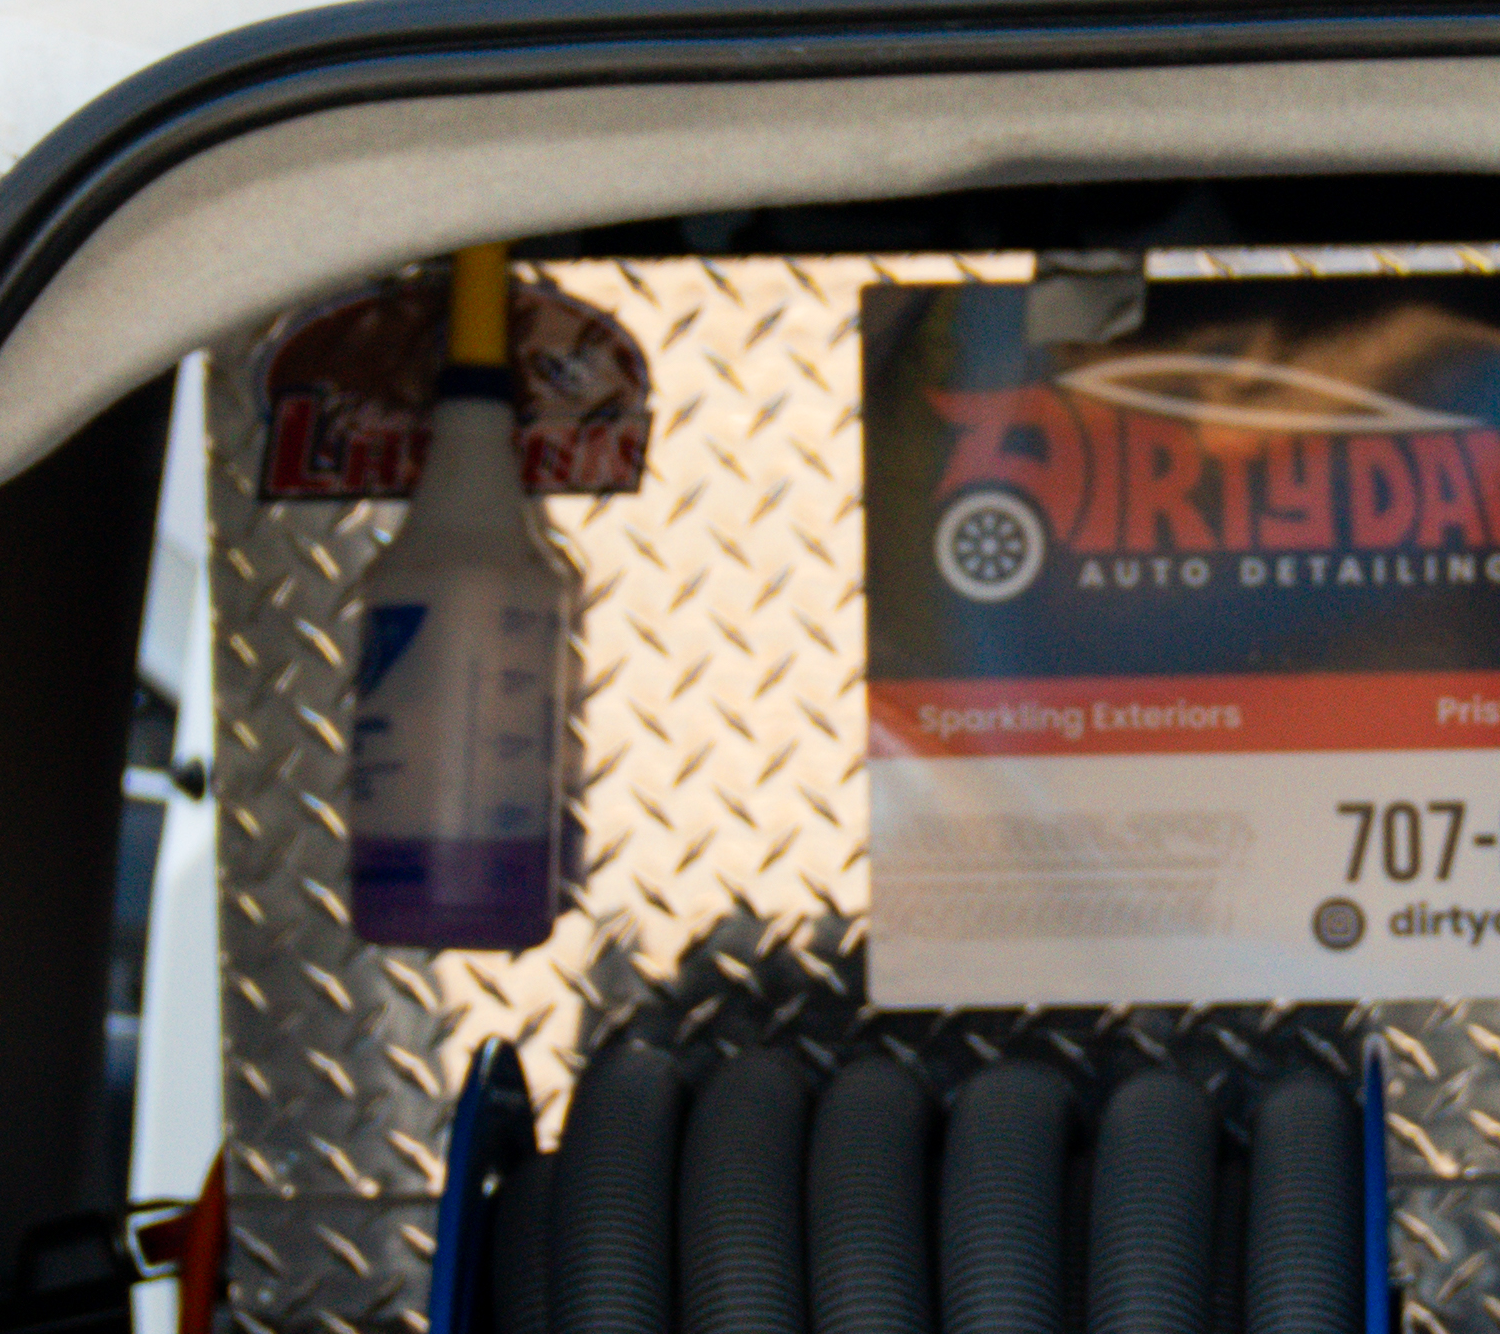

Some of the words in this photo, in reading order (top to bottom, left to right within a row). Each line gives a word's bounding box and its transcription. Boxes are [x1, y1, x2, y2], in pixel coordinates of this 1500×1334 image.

[1078, 559, 1212, 590] AUTO
[918, 701, 1086, 742] Sparkling
[1091, 698, 1242, 731] Exteriors
